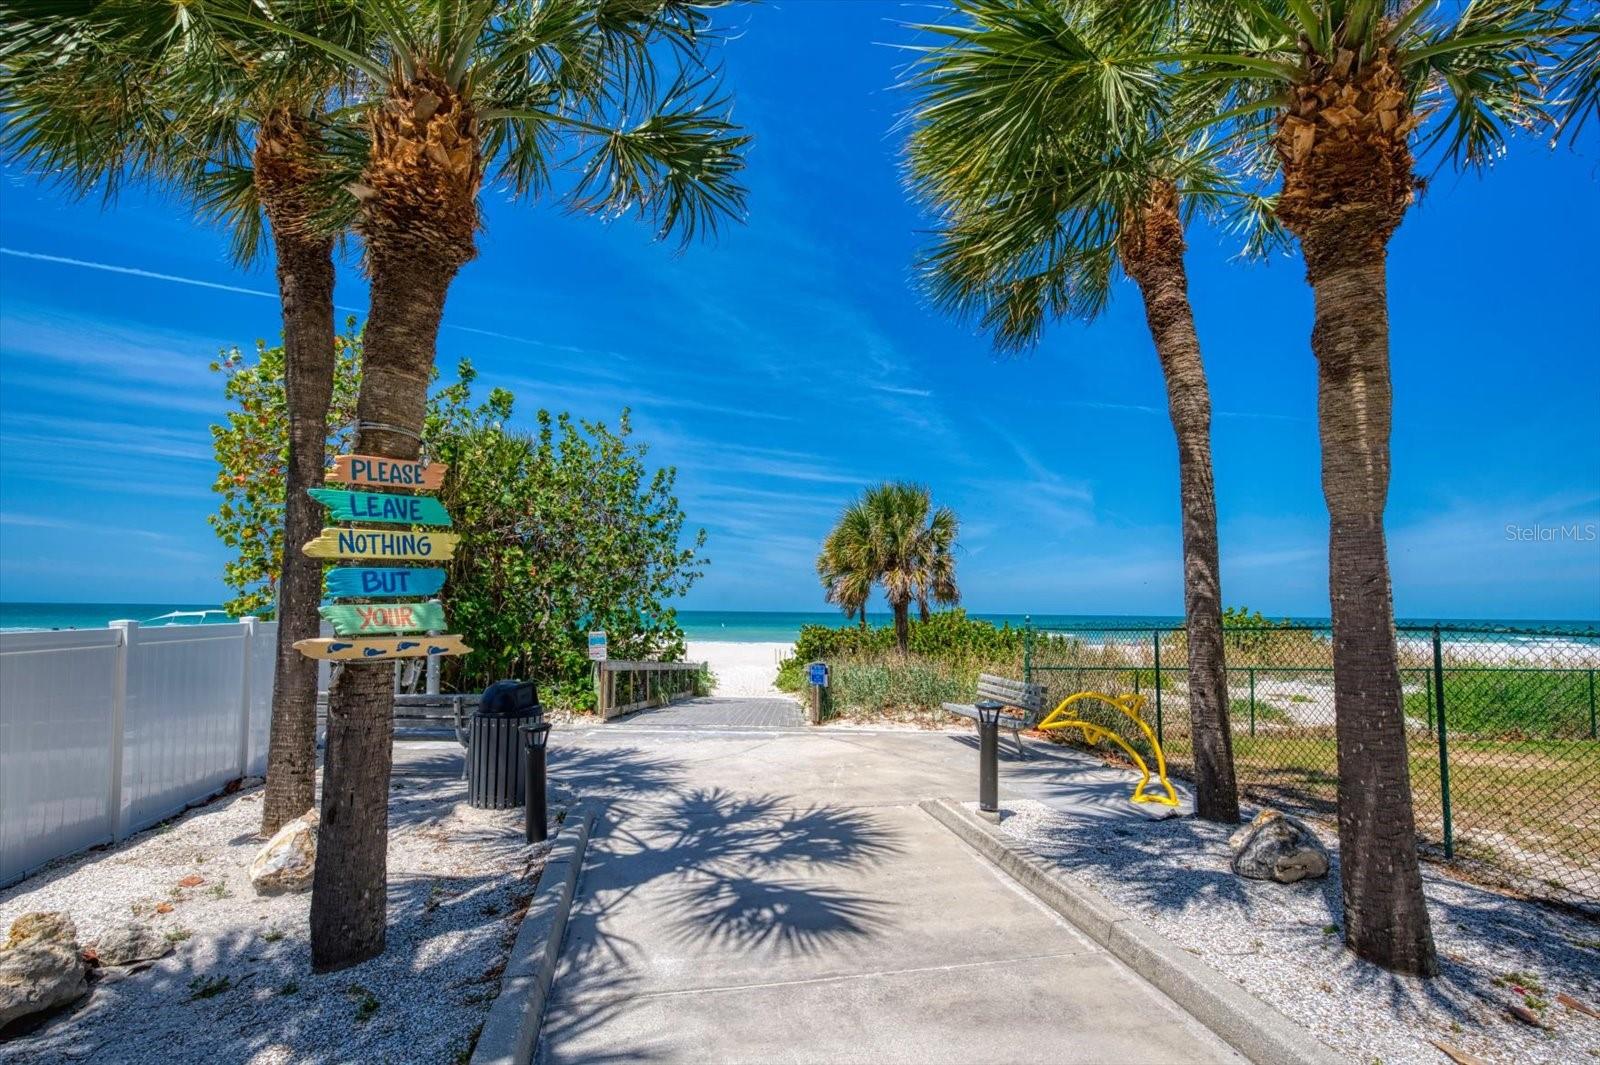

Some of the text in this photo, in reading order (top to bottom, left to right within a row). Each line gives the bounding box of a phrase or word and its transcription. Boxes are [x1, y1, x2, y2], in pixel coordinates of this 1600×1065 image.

[351, 459, 425, 484] PLEASE
[350, 494, 423, 520] LEAVE
[338, 529, 432, 556] NOTHING
[361, 570, 411, 593] BUT
[356, 607, 416, 629] YOUR
